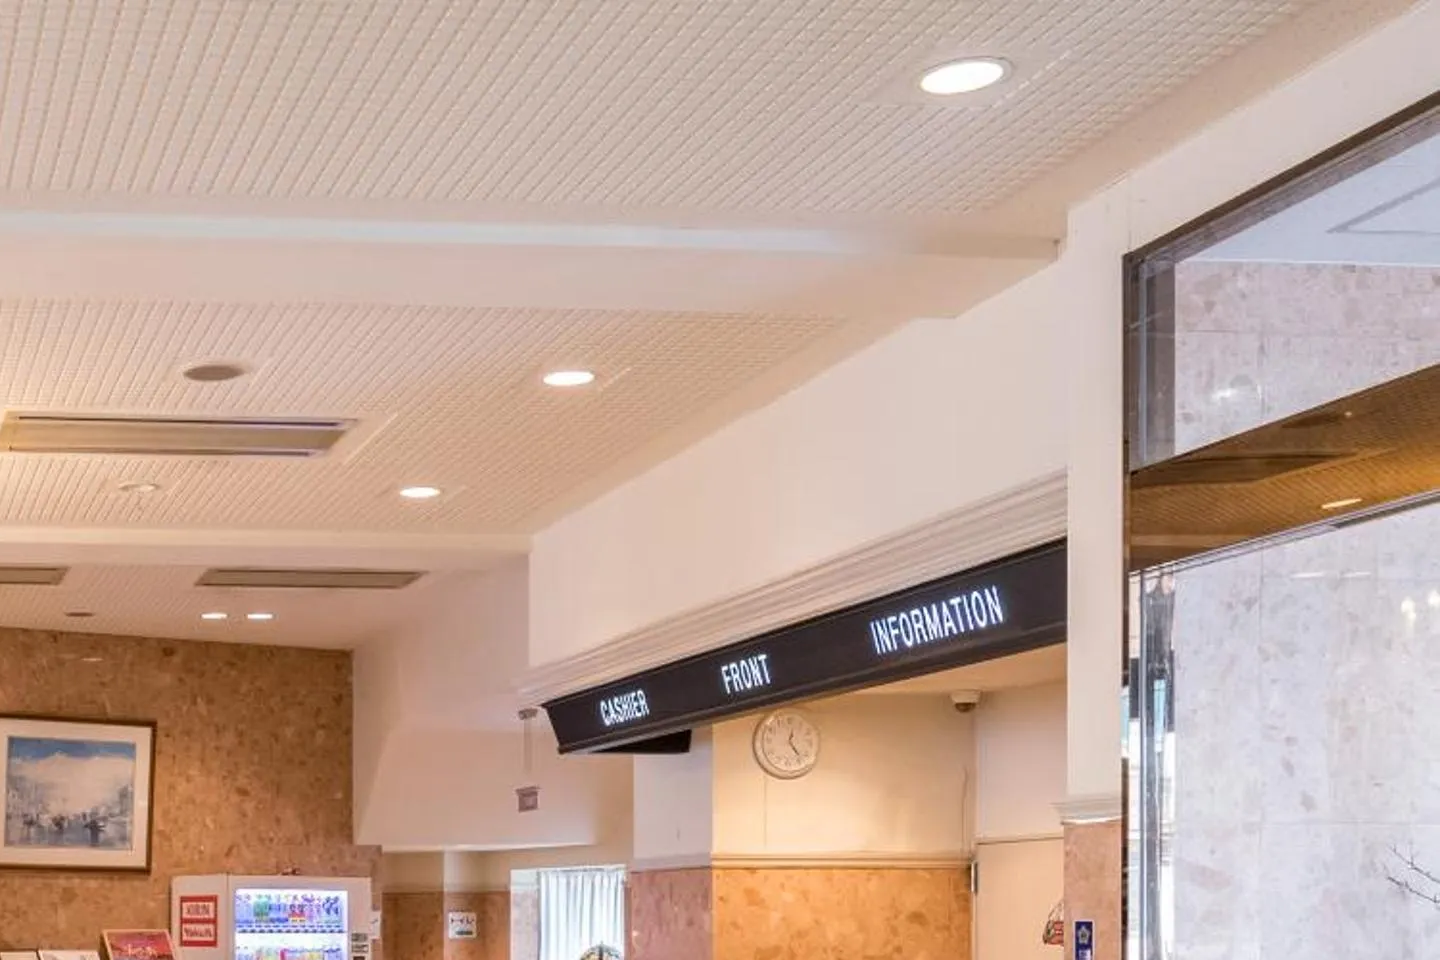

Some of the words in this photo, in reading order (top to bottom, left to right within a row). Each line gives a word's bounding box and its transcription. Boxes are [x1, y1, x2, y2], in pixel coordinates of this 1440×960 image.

[869, 584, 1004, 655] INFORMATION
[721, 654, 771, 695] FRONT
[599, 689, 650, 727] CASHIER
